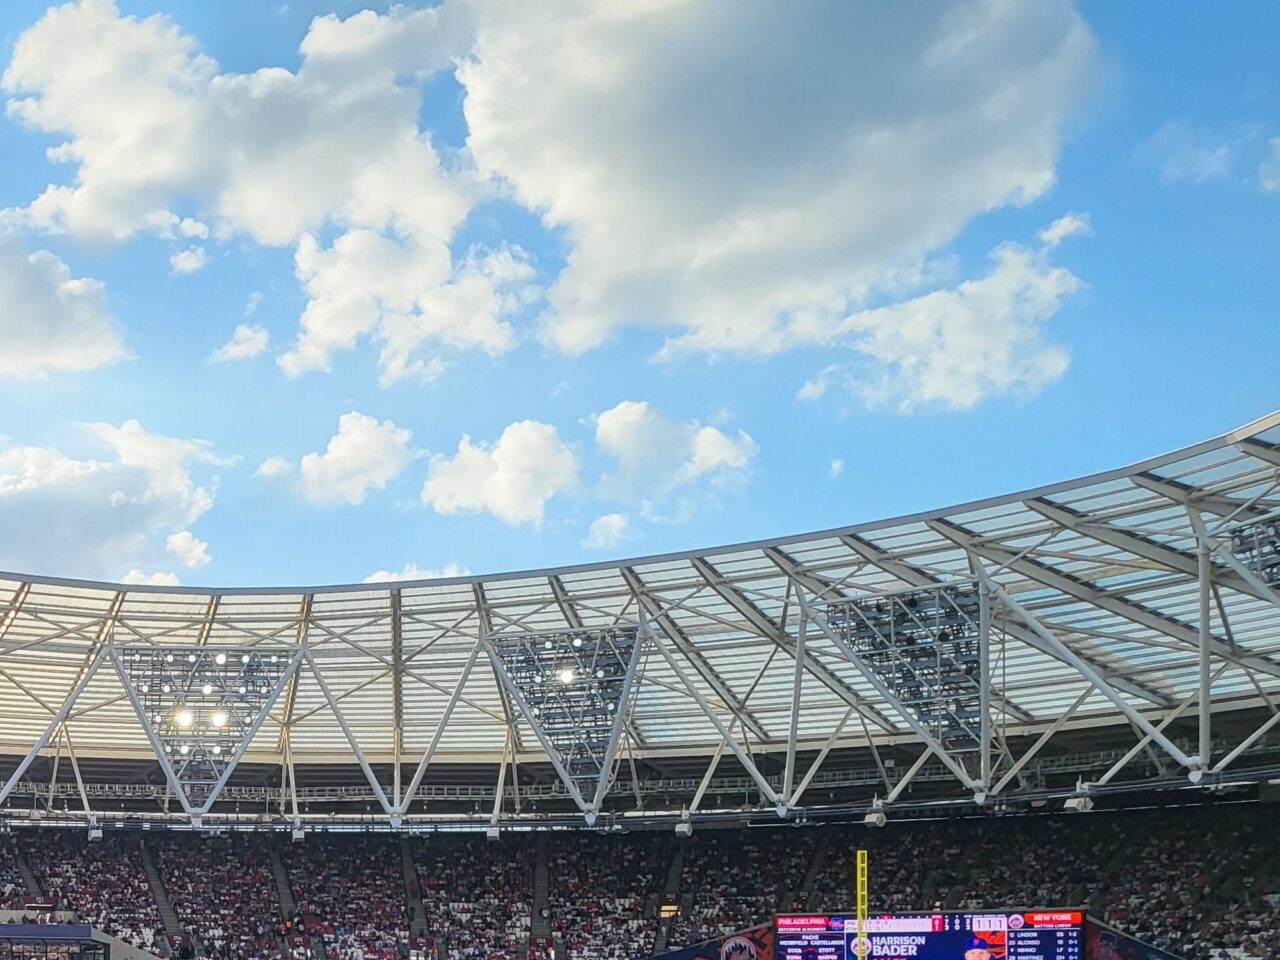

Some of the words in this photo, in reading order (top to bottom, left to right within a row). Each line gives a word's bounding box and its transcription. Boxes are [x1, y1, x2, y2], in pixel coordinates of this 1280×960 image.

[778, 918, 826, 926] PHILADELPHIA
[872, 936, 926, 946] HARRISON
[872, 946, 918, 956] BADER
